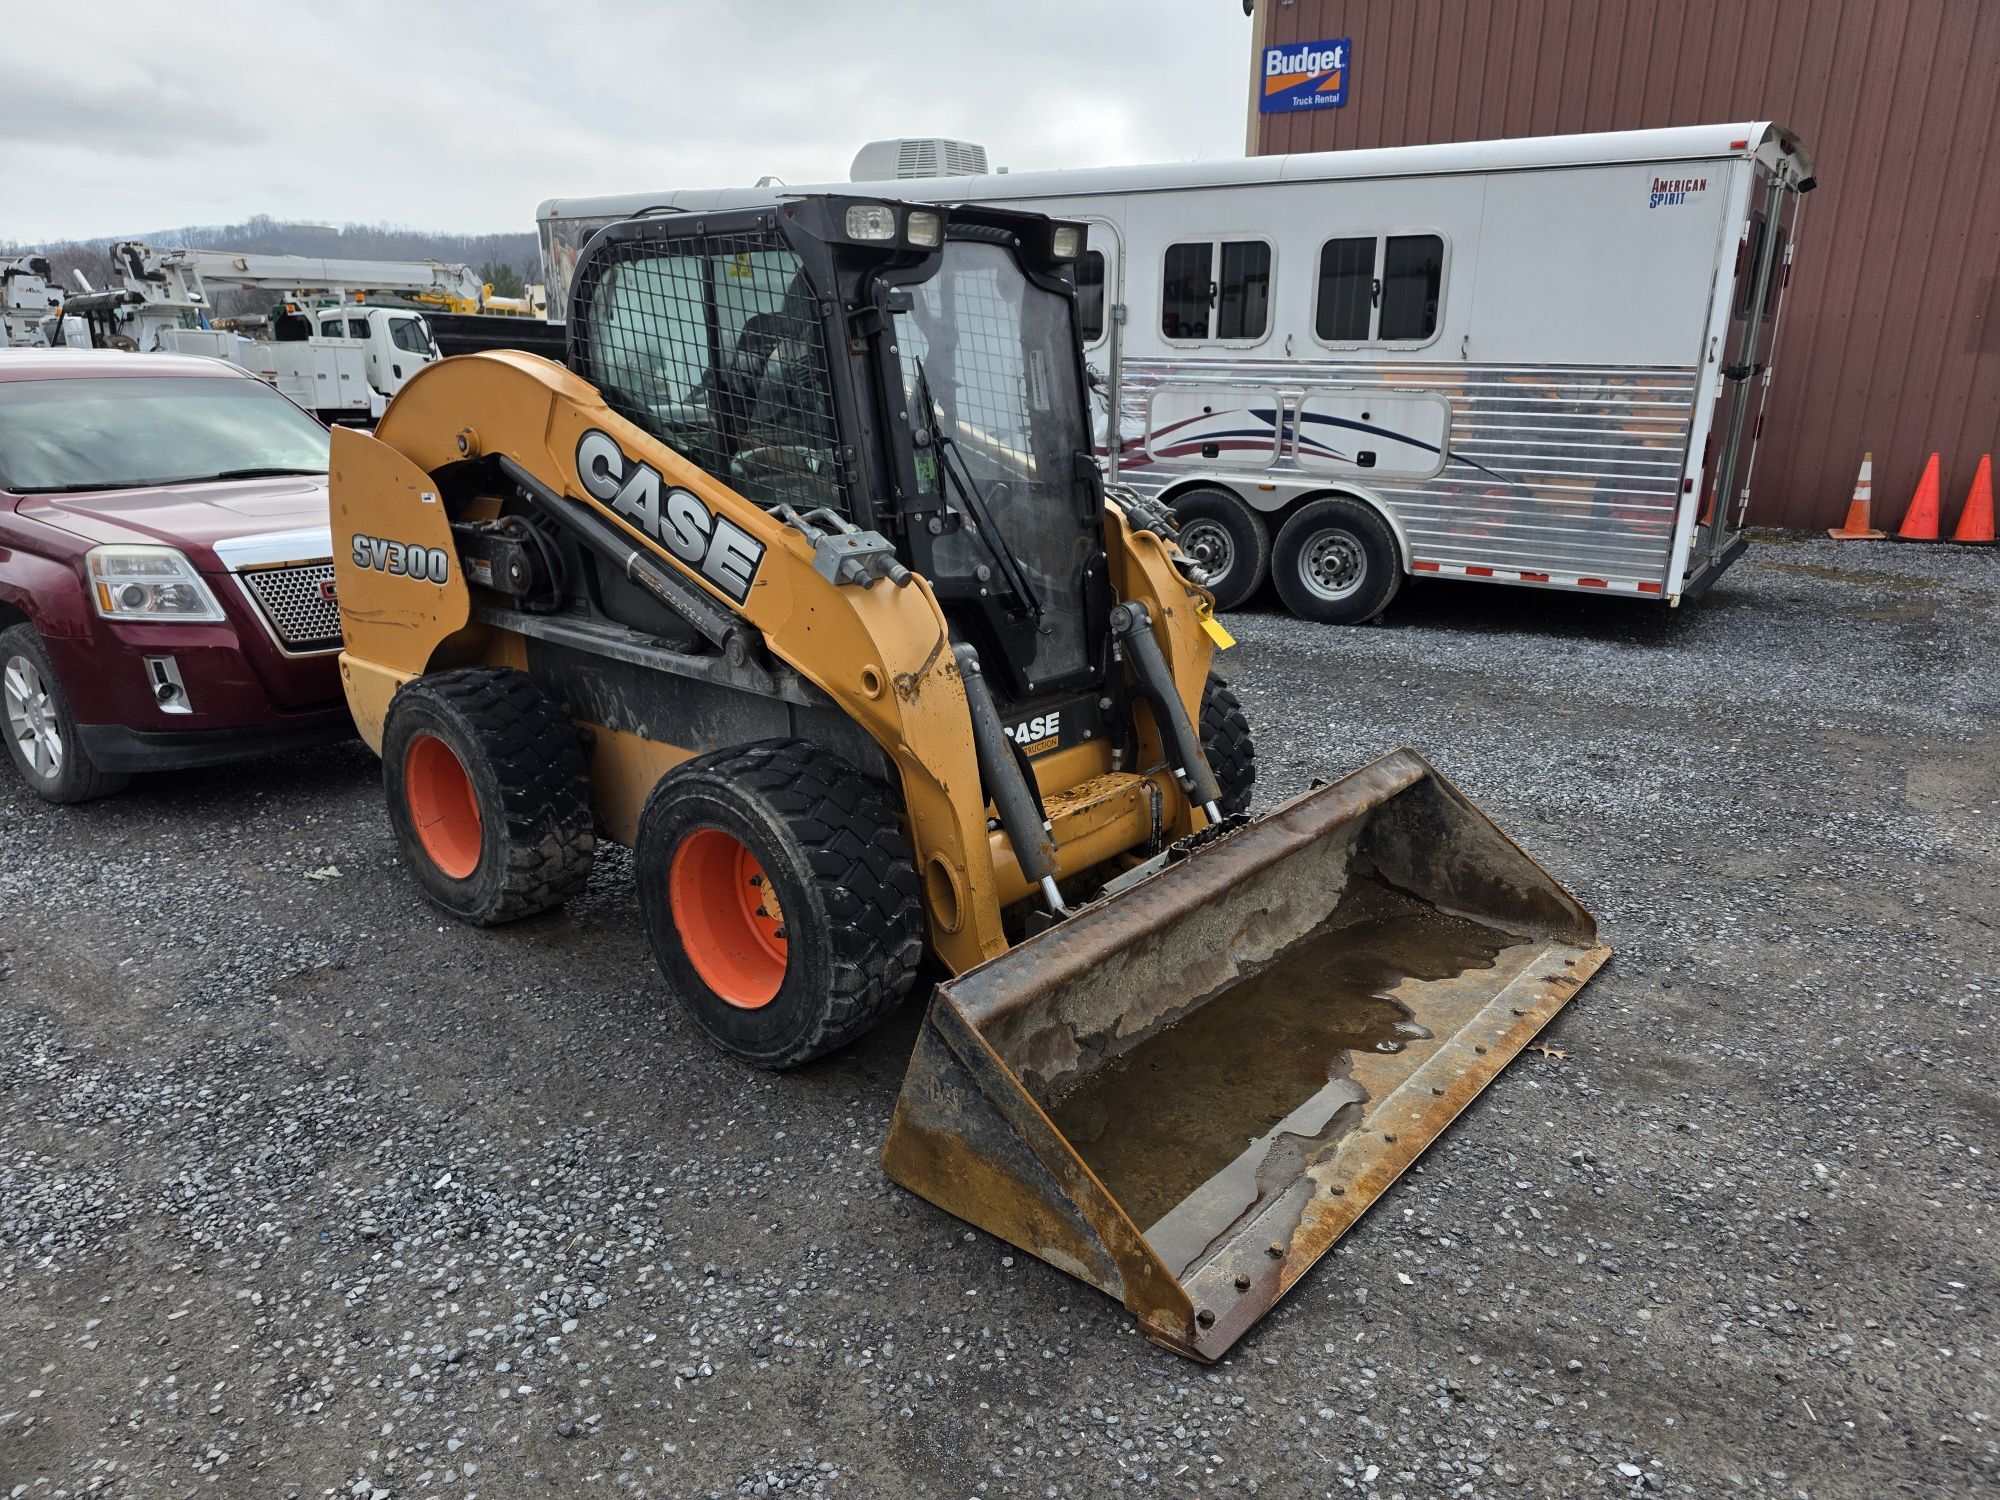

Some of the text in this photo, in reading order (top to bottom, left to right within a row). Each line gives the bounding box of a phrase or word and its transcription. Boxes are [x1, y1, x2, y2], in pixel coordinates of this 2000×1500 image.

[1266, 45, 1343, 78] Budget
[1292, 93, 1340, 106] Truck Rental
[1651, 177, 1707, 193] AMERICAN
[1649, 192, 1686, 208] SPIRIT
[576, 430, 765, 604] CASE
[352, 533, 449, 585] SV300
[1023, 738, 1058, 755] TRUCTION
